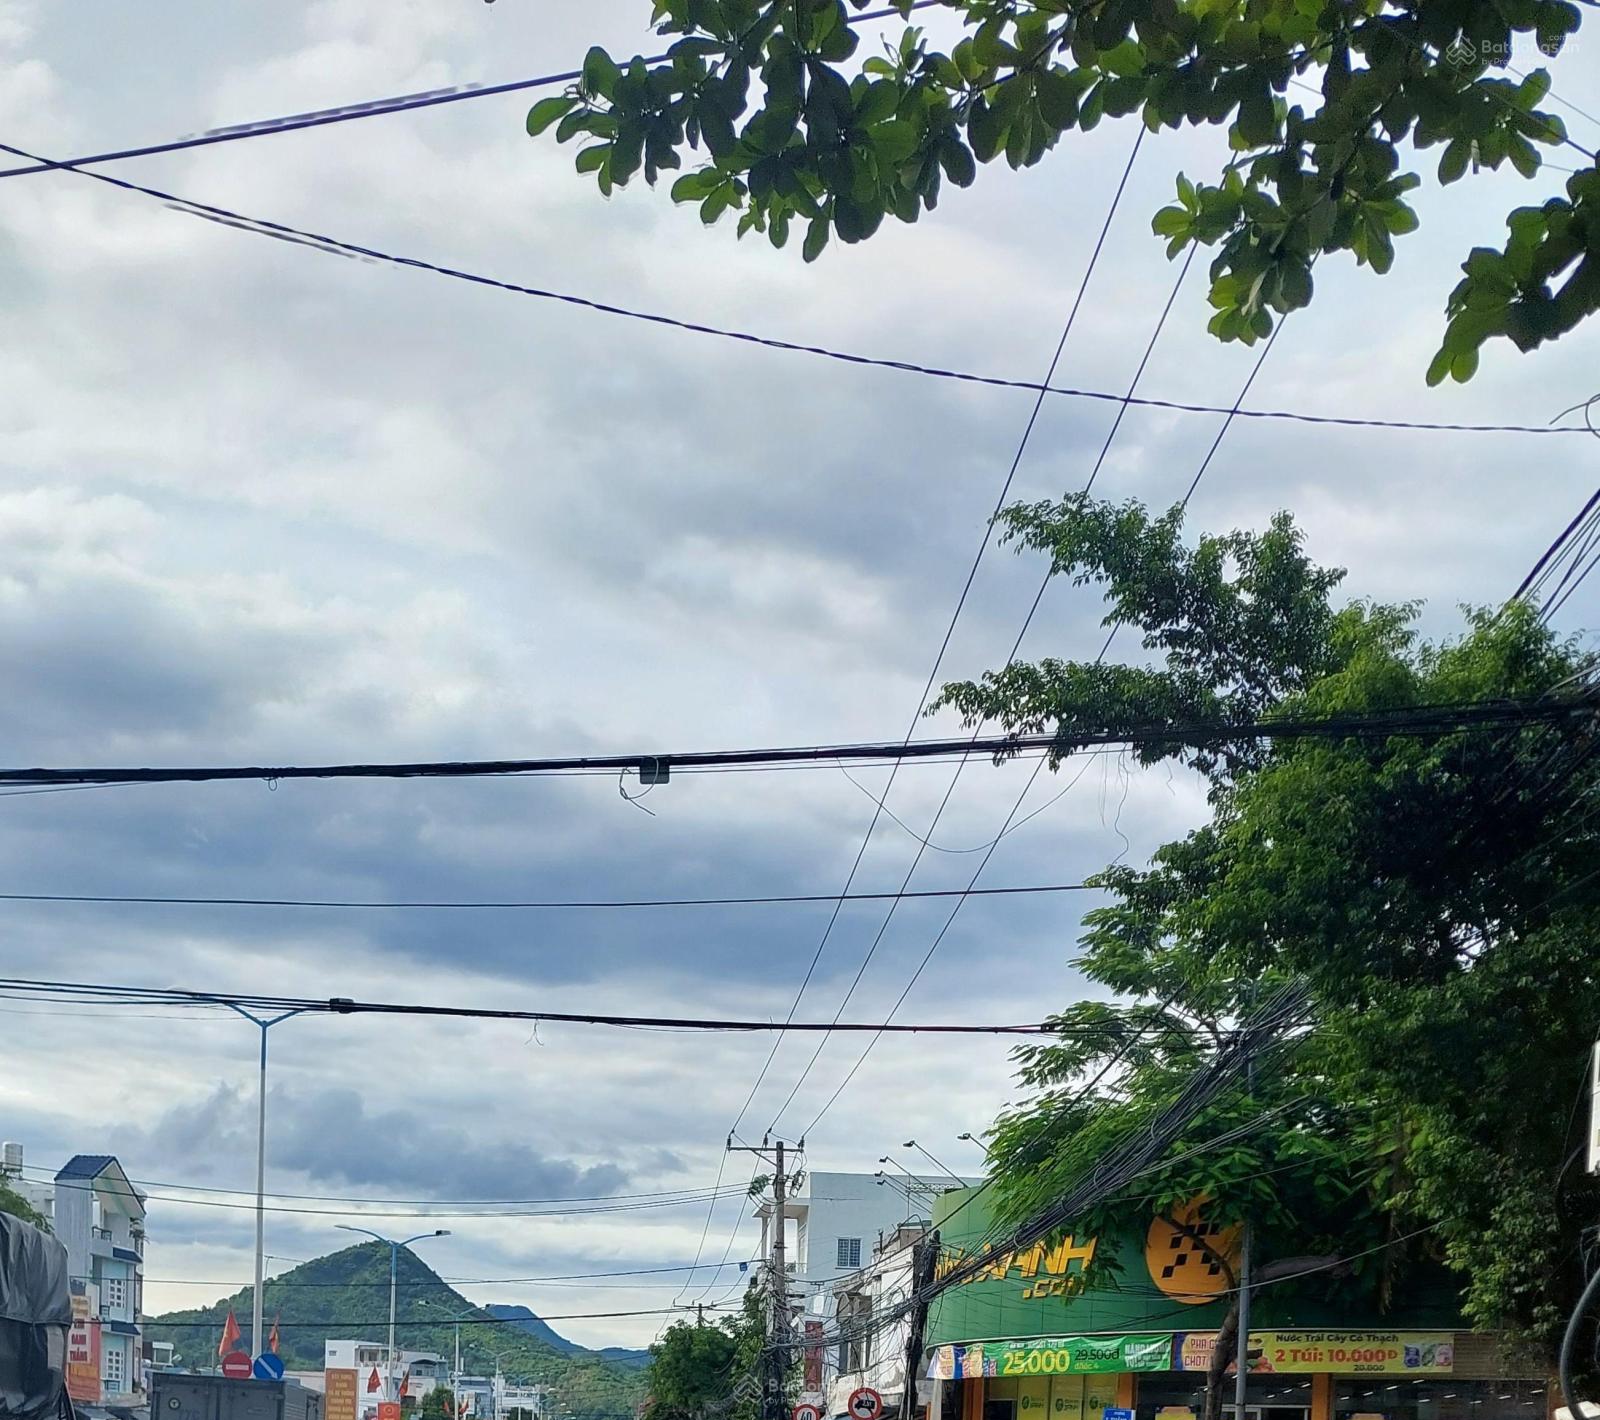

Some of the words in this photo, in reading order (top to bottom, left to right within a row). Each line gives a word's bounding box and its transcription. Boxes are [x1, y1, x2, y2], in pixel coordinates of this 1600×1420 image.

[1003, 1349, 1071, 1375] 25.000
[1275, 1349, 1286, 1362] 2
[1290, 1347, 1323, 1362] Túi:
